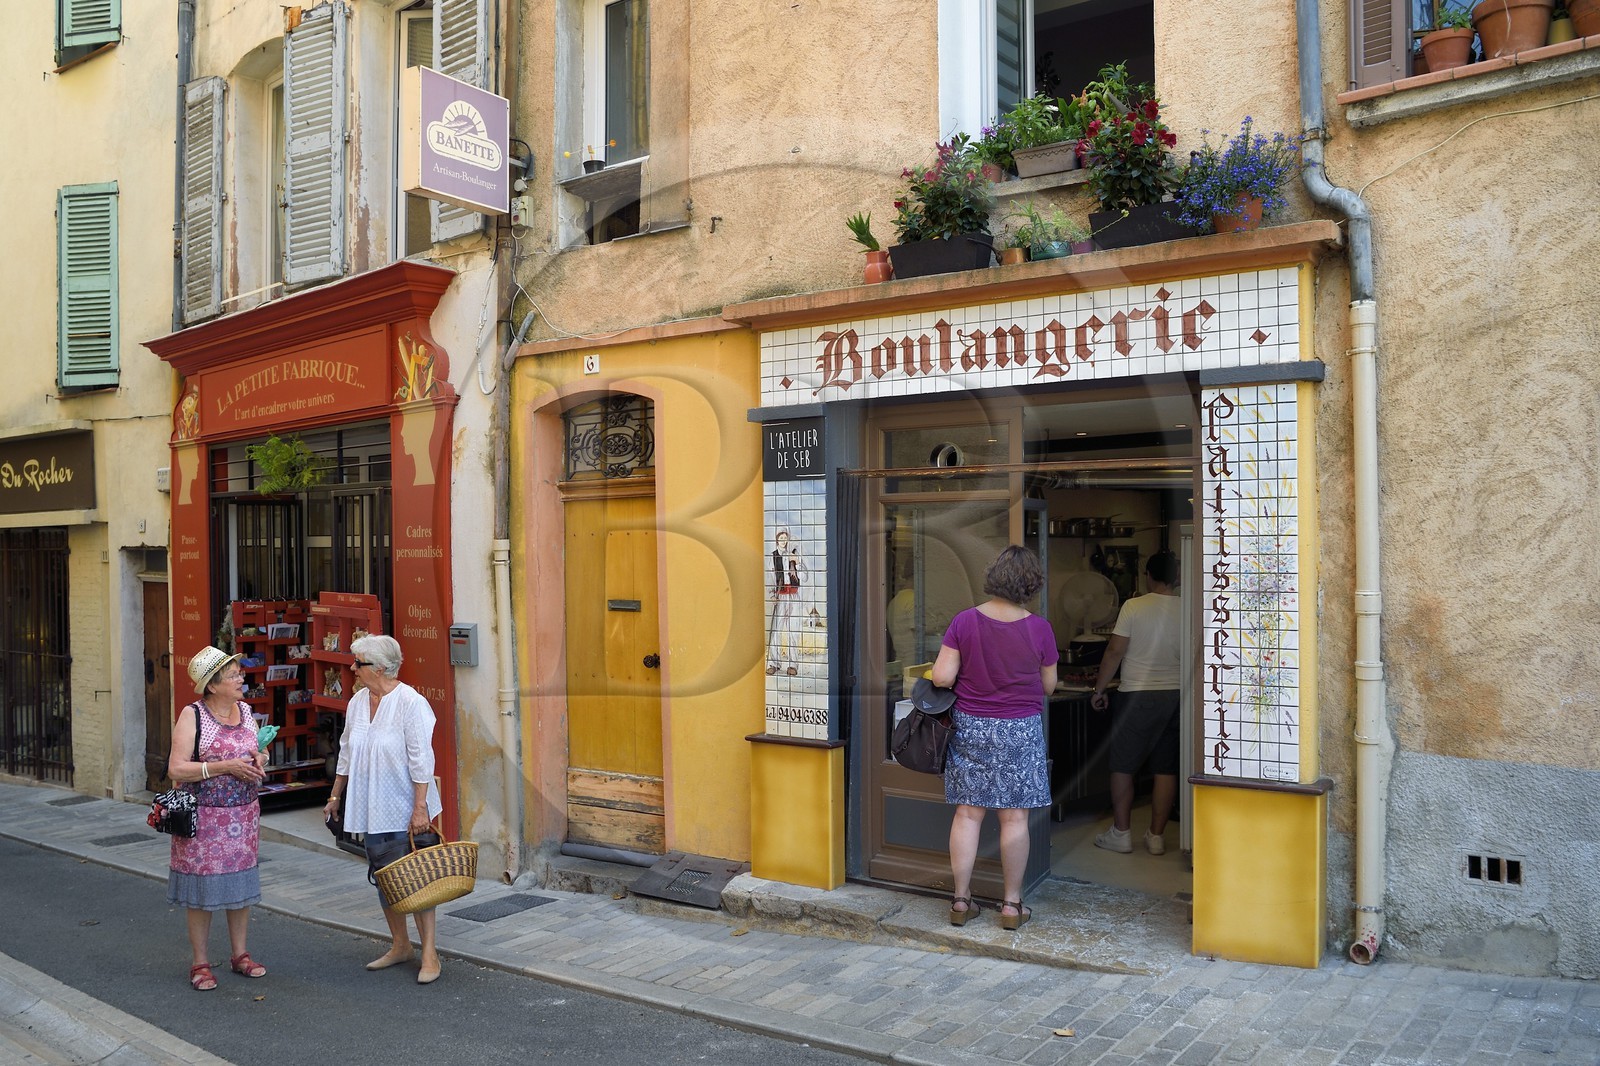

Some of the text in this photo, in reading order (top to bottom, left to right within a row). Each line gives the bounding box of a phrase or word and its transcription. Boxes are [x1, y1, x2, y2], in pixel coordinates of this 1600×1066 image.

[436, 130, 495, 161] BANETTE
[432, 162, 497, 190] Artisan-Boulanger
[812, 286, 1217, 397] Boulangerie
[586, 355, 595, 372] 6
[216, 390, 234, 416] LA
[234, 364, 280, 401] PETITE
[234, 393, 335, 421] L'art d'encadrer votre univers
[769, 428, 818, 450] L'ATELIER
[777, 449, 811, 469] DE SEB
[0, 456, 74, 492] Du Rocher
[181, 534, 198, 545] Passe-
[406, 525, 433, 538] Cadres
[179, 550, 200, 562] partout
[396, 545, 444, 561] personnalisés
[1202, 391, 1235, 772] Patisserie
[183, 595, 198, 606] Devis
[180, 610, 201, 621] Conseils
[408, 604, 432, 622] Objets
[402, 626, 438, 640] décoratifs
[778, 706, 790, 721] 94
[790, 708, 802, 722] 04
[803, 709, 815, 724] 63
[815, 710, 828, 725] 88
